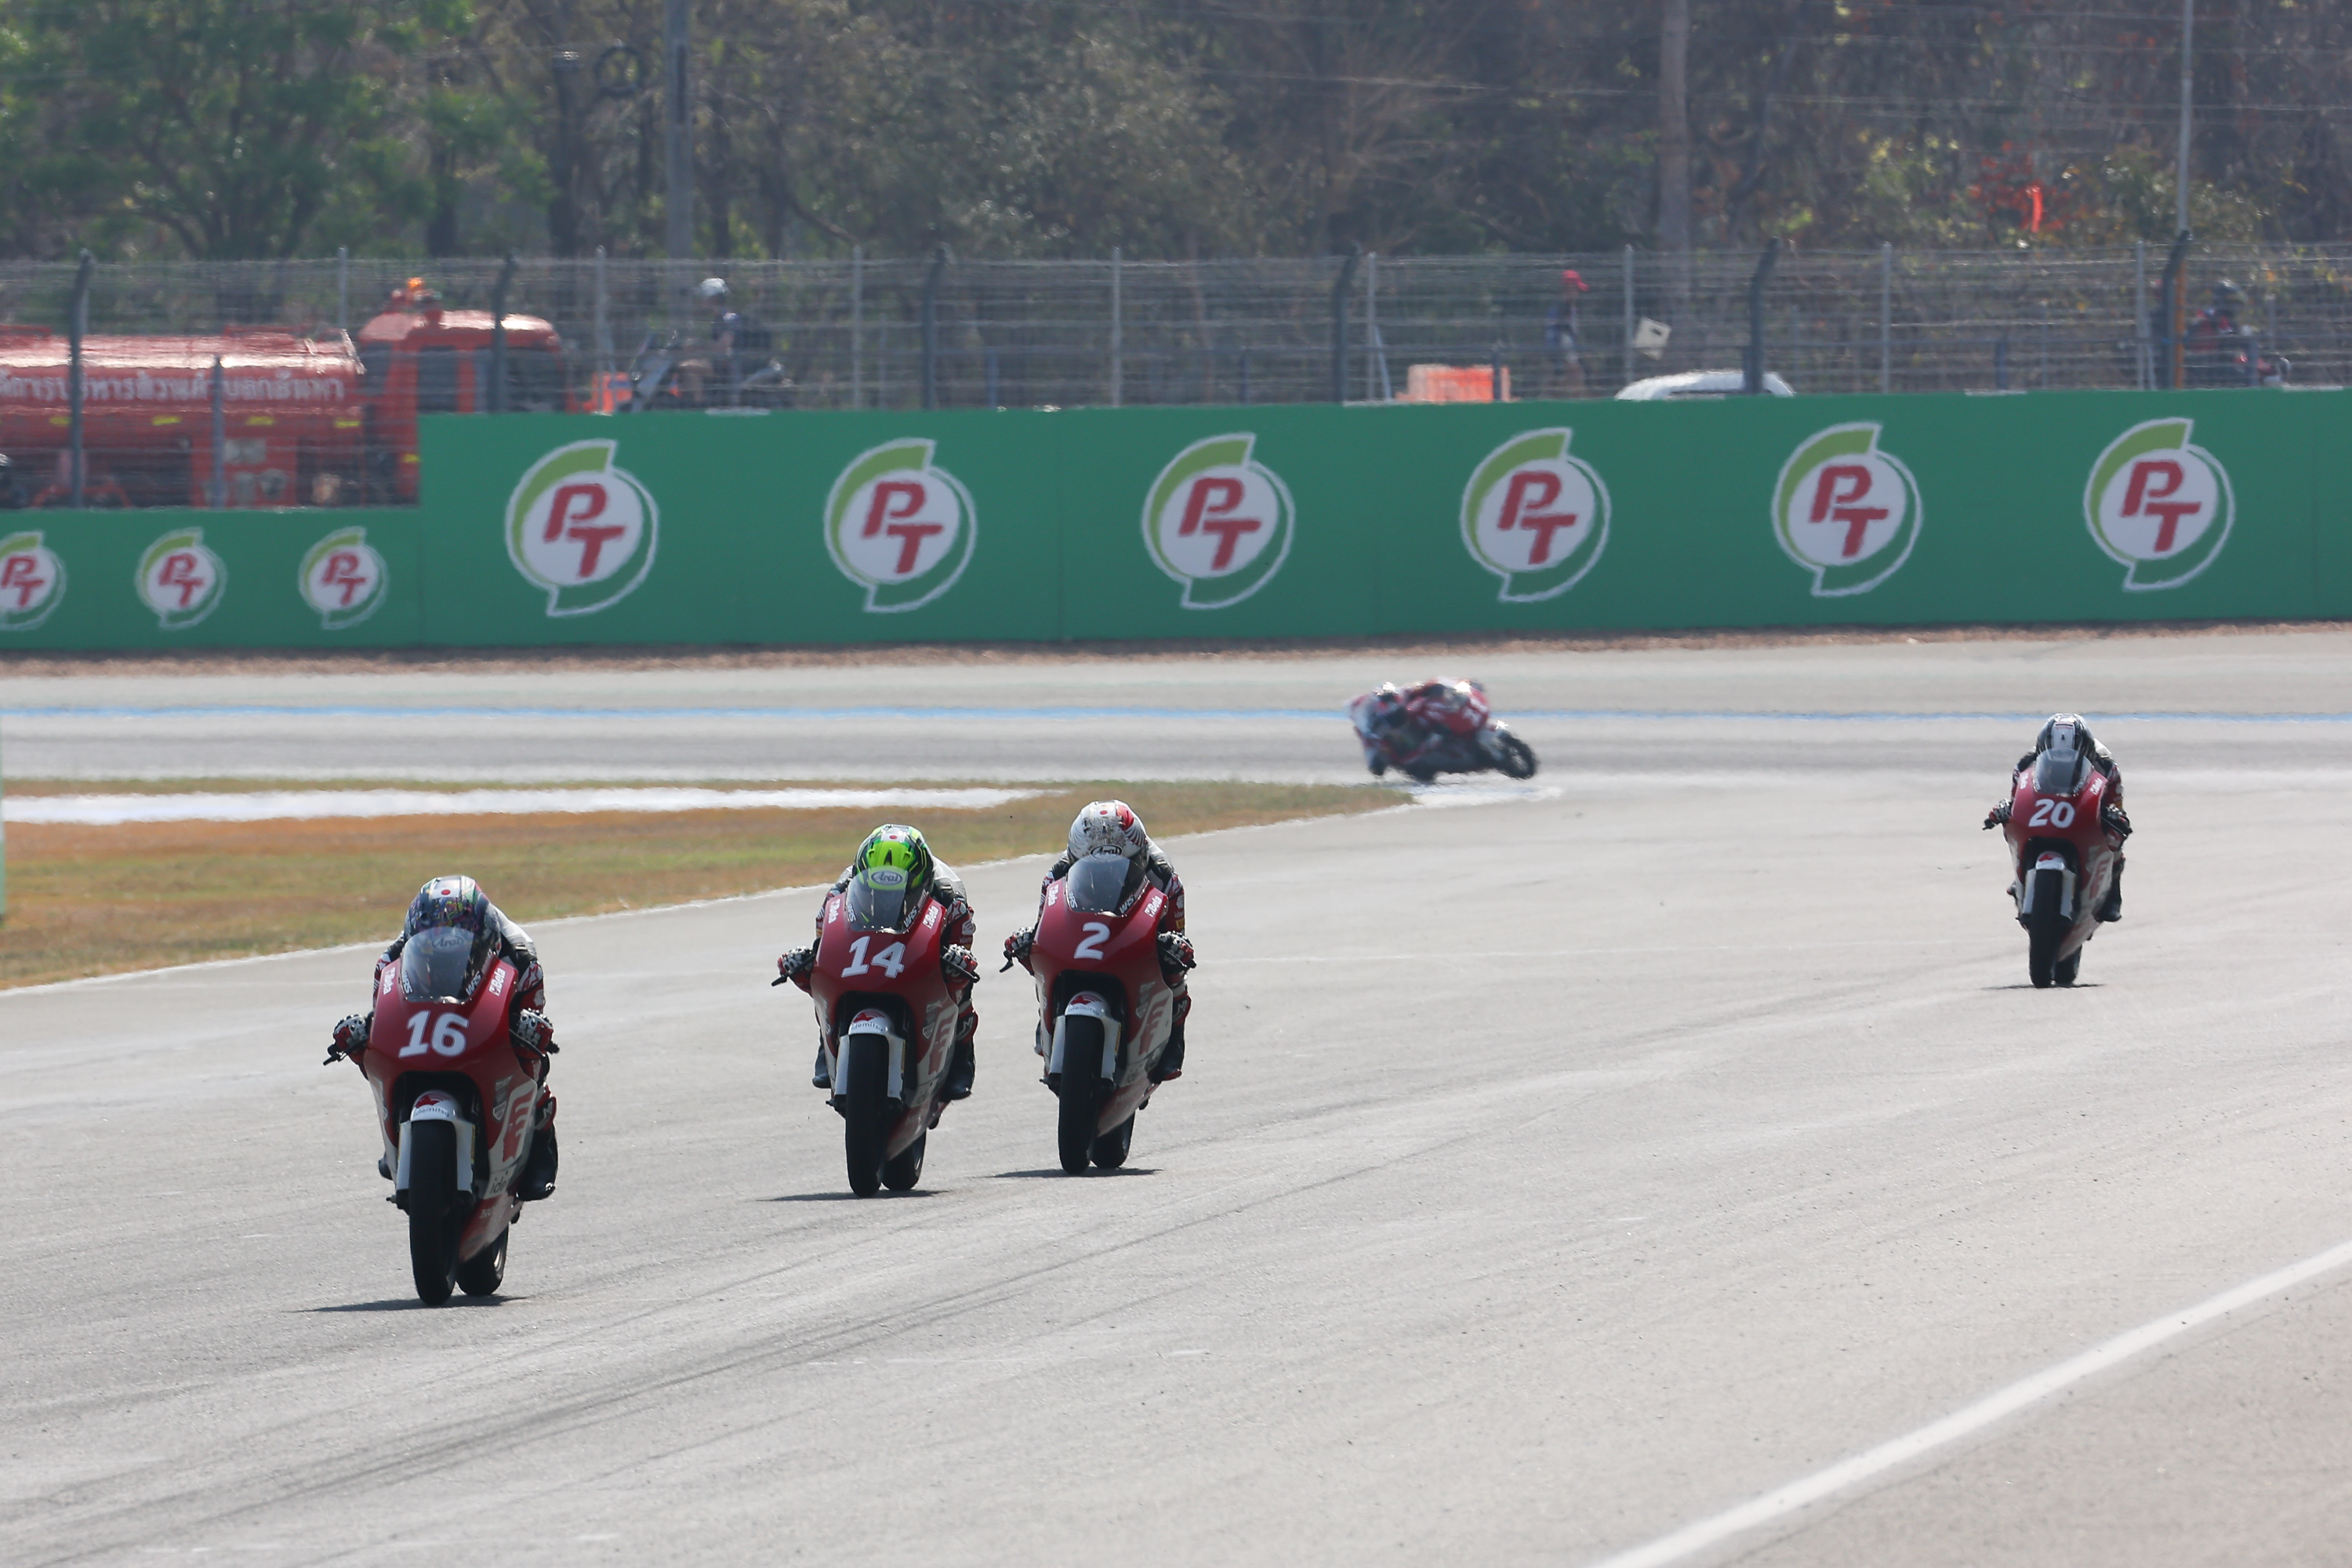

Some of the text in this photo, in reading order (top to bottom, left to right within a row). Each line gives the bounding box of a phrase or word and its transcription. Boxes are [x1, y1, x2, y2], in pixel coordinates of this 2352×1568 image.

[859, 481, 944, 574] PT
[1178, 477, 1262, 571] PT
[1496, 470, 1577, 564] PT
[1808, 465, 1889, 557] PT
[2120, 459, 2202, 552] PT
[543, 482, 626, 578] PT
[1, 556, 45, 609] PT
[158, 553, 205, 608] PT
[321, 552, 367, 605] PT
[2029, 798, 2075, 829] 20
[877, 872, 898, 883] Arai
[903, 906, 918, 928] WRS
[924, 905, 940, 926] Beta
[1119, 895, 1135, 915] WRS
[1149, 895, 1163, 914] Beta
[841, 935, 906, 978] 14
[1073, 921, 1110, 960] 2
[465, 971, 482, 996] WRS
[494, 967, 506, 990] Beta
[398, 1011, 470, 1058] 16
